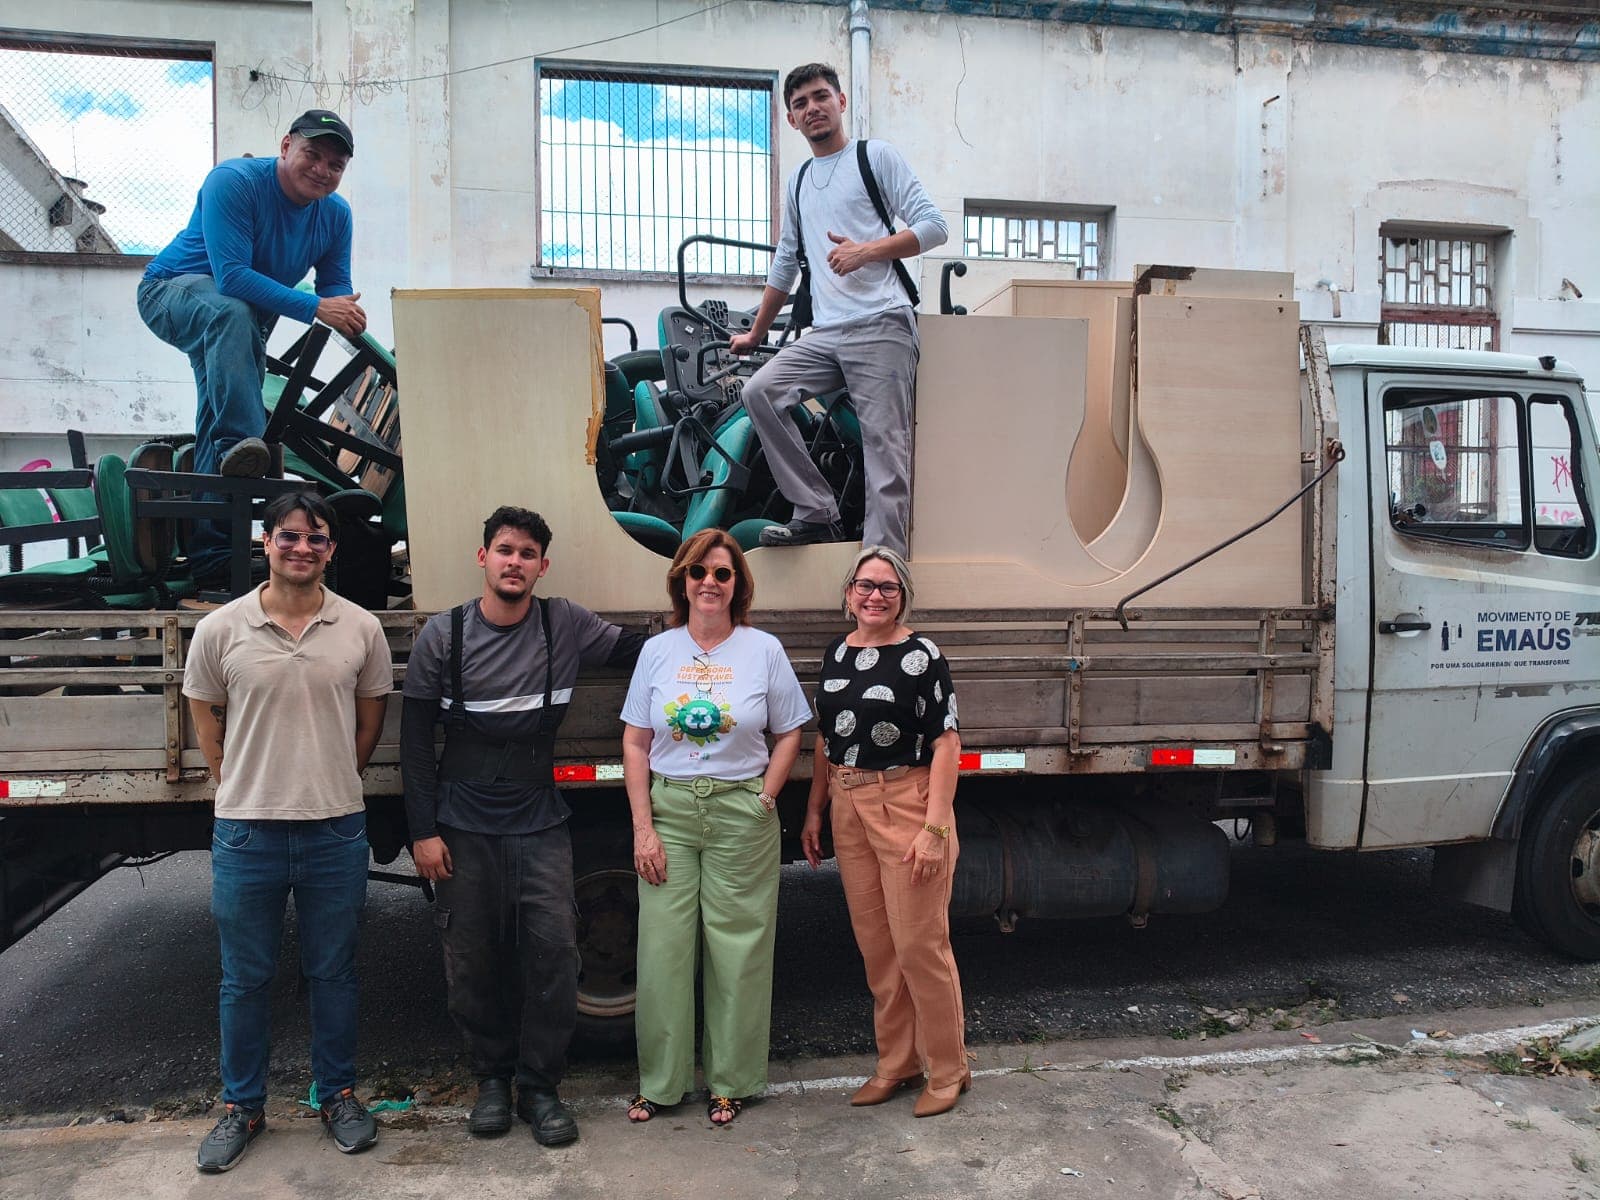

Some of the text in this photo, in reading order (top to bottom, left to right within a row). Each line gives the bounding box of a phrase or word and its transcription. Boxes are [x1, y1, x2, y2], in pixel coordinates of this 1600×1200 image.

[1477, 610, 1571, 622] MOVIMENTO DE
[1477, 623, 1571, 652] EMAÚS
